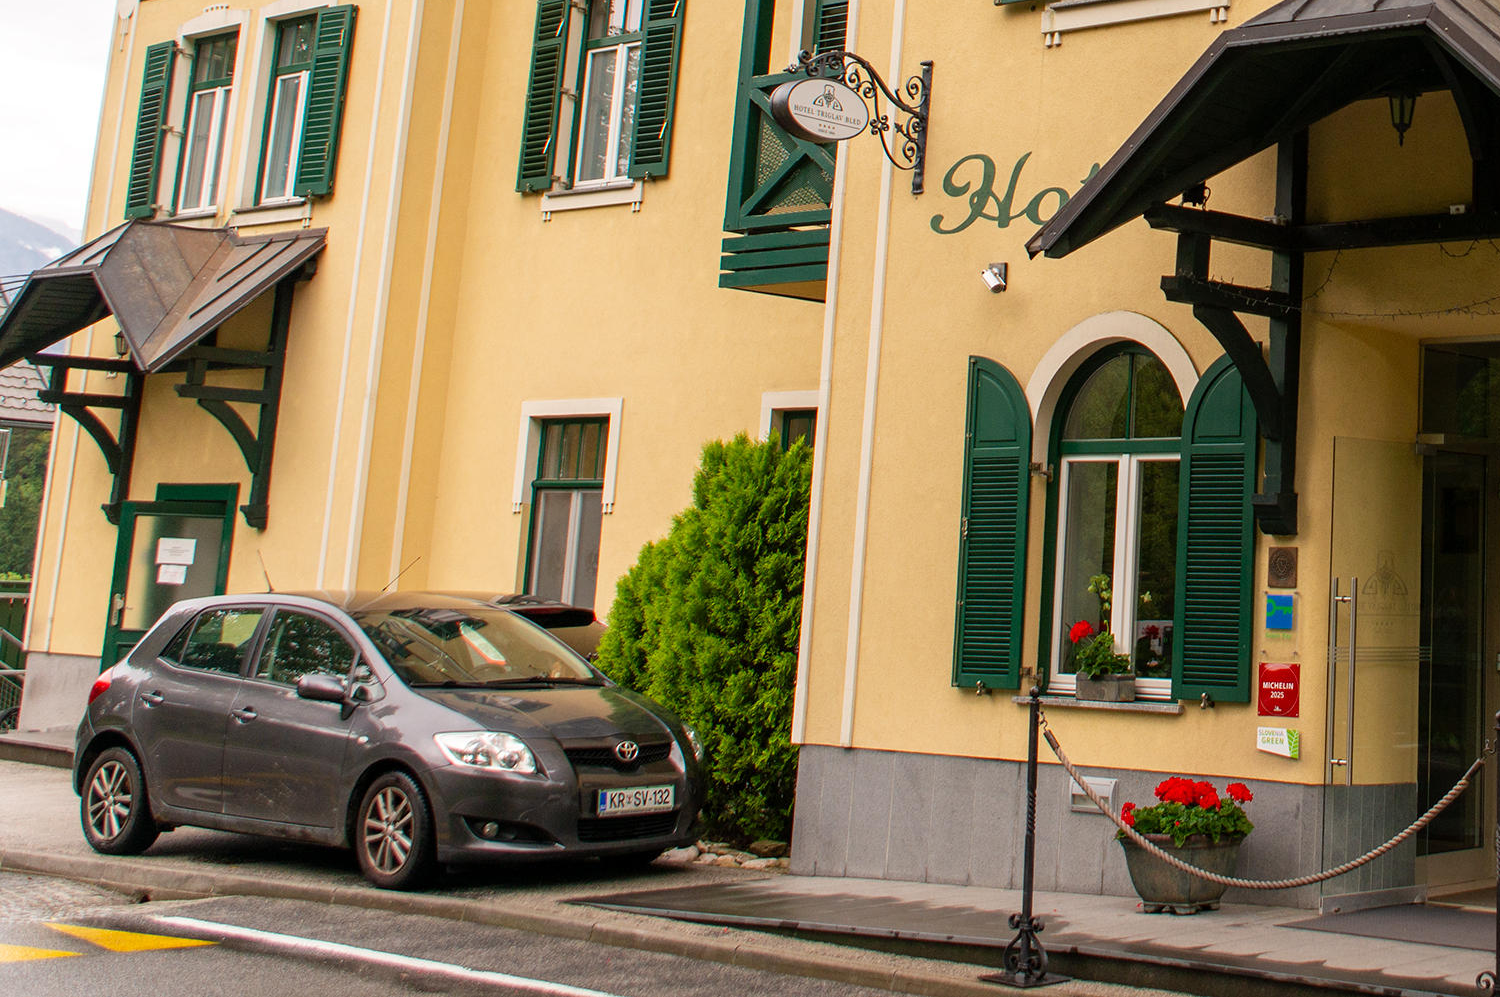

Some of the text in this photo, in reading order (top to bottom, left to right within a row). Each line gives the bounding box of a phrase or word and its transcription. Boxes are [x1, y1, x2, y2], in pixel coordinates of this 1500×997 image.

[794, 104, 862, 125] HOTEL TRIGLAV BLED
[1262, 682, 1294, 690] MICHELIN
[1270, 691, 1285, 699] 2025
[1261, 736, 1285, 744] GREEN
[609, 788, 671, 809] KR SV-132
